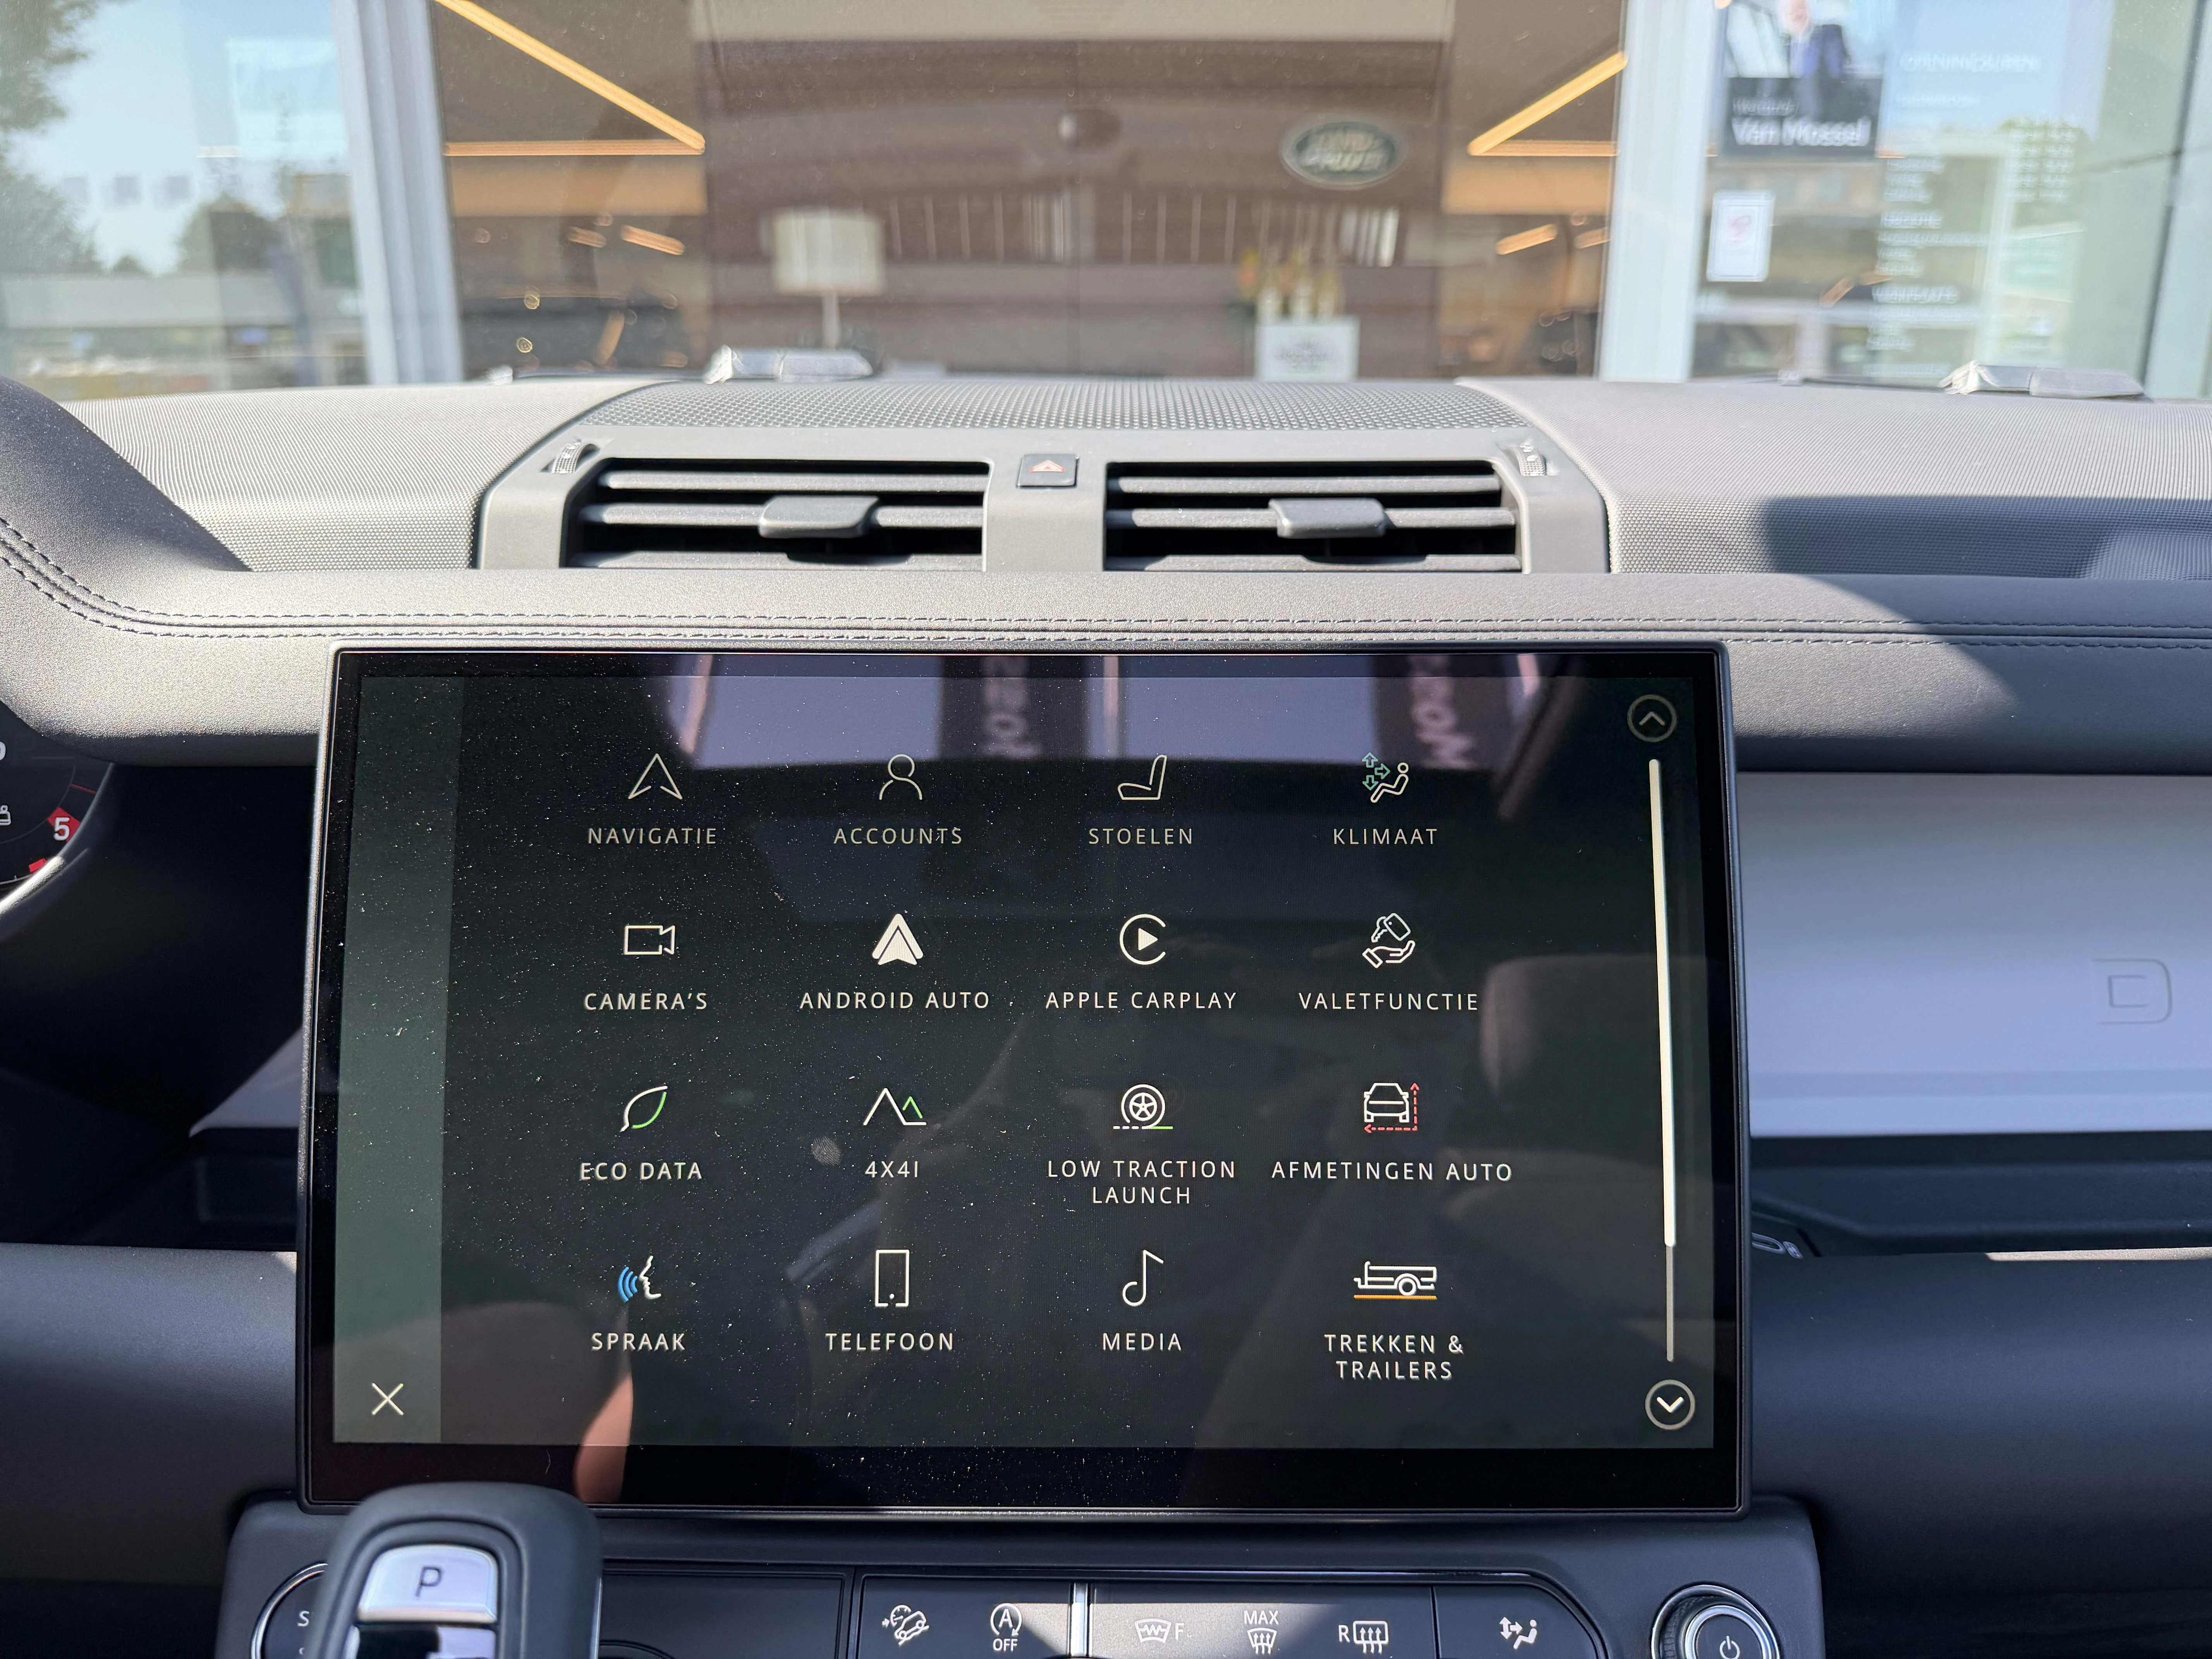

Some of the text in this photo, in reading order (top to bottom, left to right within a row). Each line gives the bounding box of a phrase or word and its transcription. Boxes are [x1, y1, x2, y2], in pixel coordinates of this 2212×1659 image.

[53, 817, 70, 841] 5
[588, 828, 717, 844] NAVIGATIE
[833, 827, 962, 844] ACCOUNTS
[1088, 828, 1192, 845] STOELEN
[1333, 828, 1437, 845] KLIMAAT
[584, 992, 708, 1010] CAMERA'S
[800, 991, 989, 1009] ANDROID AUTO
[1046, 991, 1237, 1009] APPLE CARPLAY
[1298, 992, 1478, 1010] VALETFUNCTIE
[579, 1162, 702, 1180] ECO DATA
[1048, 1160, 1235, 1178] LOW TRACTION
[1271, 1161, 1512, 1181] AFMETINGEN AUTO
[1092, 1186, 1190, 1204] LAUNCH
[591, 1332, 685, 1351] SPRAAK
[825, 1332, 953, 1351] TELEFOON
[1103, 1333, 1182, 1351] MEDIA
[1324, 1334, 1464, 1354] TREKKEN &
[1336, 1360, 1452, 1379] TRAILERS
[414, 1566, 443, 1597] P
[1244, 1610, 1279, 1625] MAX
[1175, 1623, 1184, 1640] F
[1338, 1625, 1350, 1642] R
[993, 1638, 1018, 1652] OFF
